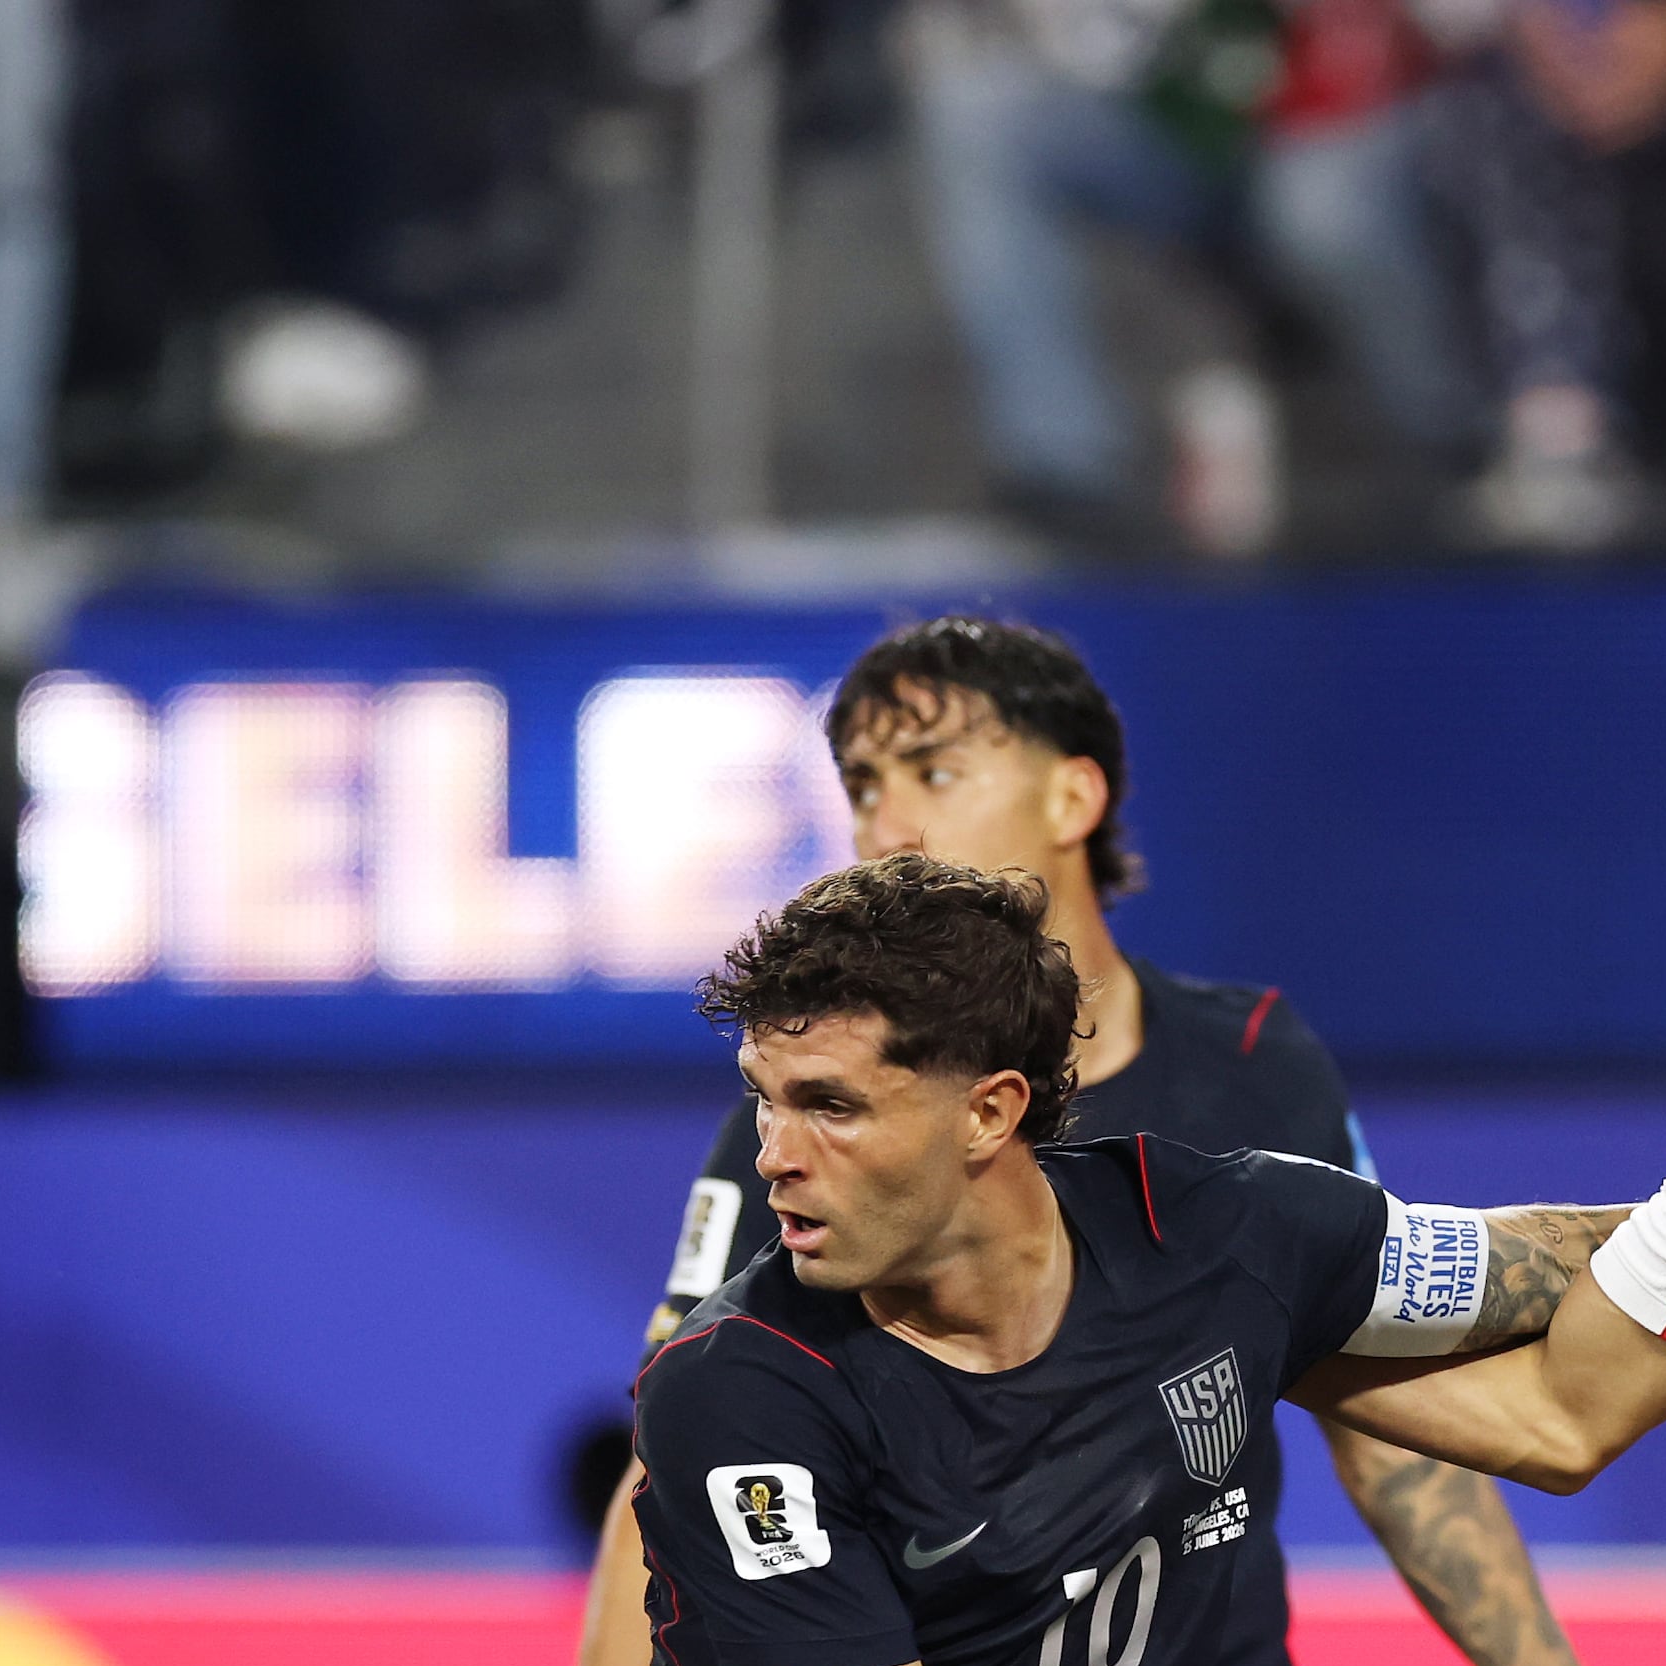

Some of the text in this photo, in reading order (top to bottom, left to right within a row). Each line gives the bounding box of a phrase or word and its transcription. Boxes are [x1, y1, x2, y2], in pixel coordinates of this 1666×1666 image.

[1383, 1239, 1400, 1286] FIFA
[1393, 1214, 1429, 1323] the World
[1422, 1219, 1458, 1318] UNITES
[1450, 1220, 1479, 1317] FOOTBALL
[1168, 1358, 1235, 1419] USA
[1224, 1487, 1247, 1506] USA
[1236, 1503, 1250, 1519] CA
[759, 1551, 805, 1568] 2026
[1194, 1530, 1221, 1551] JUNE
[1221, 1521, 1246, 1542] 2026
